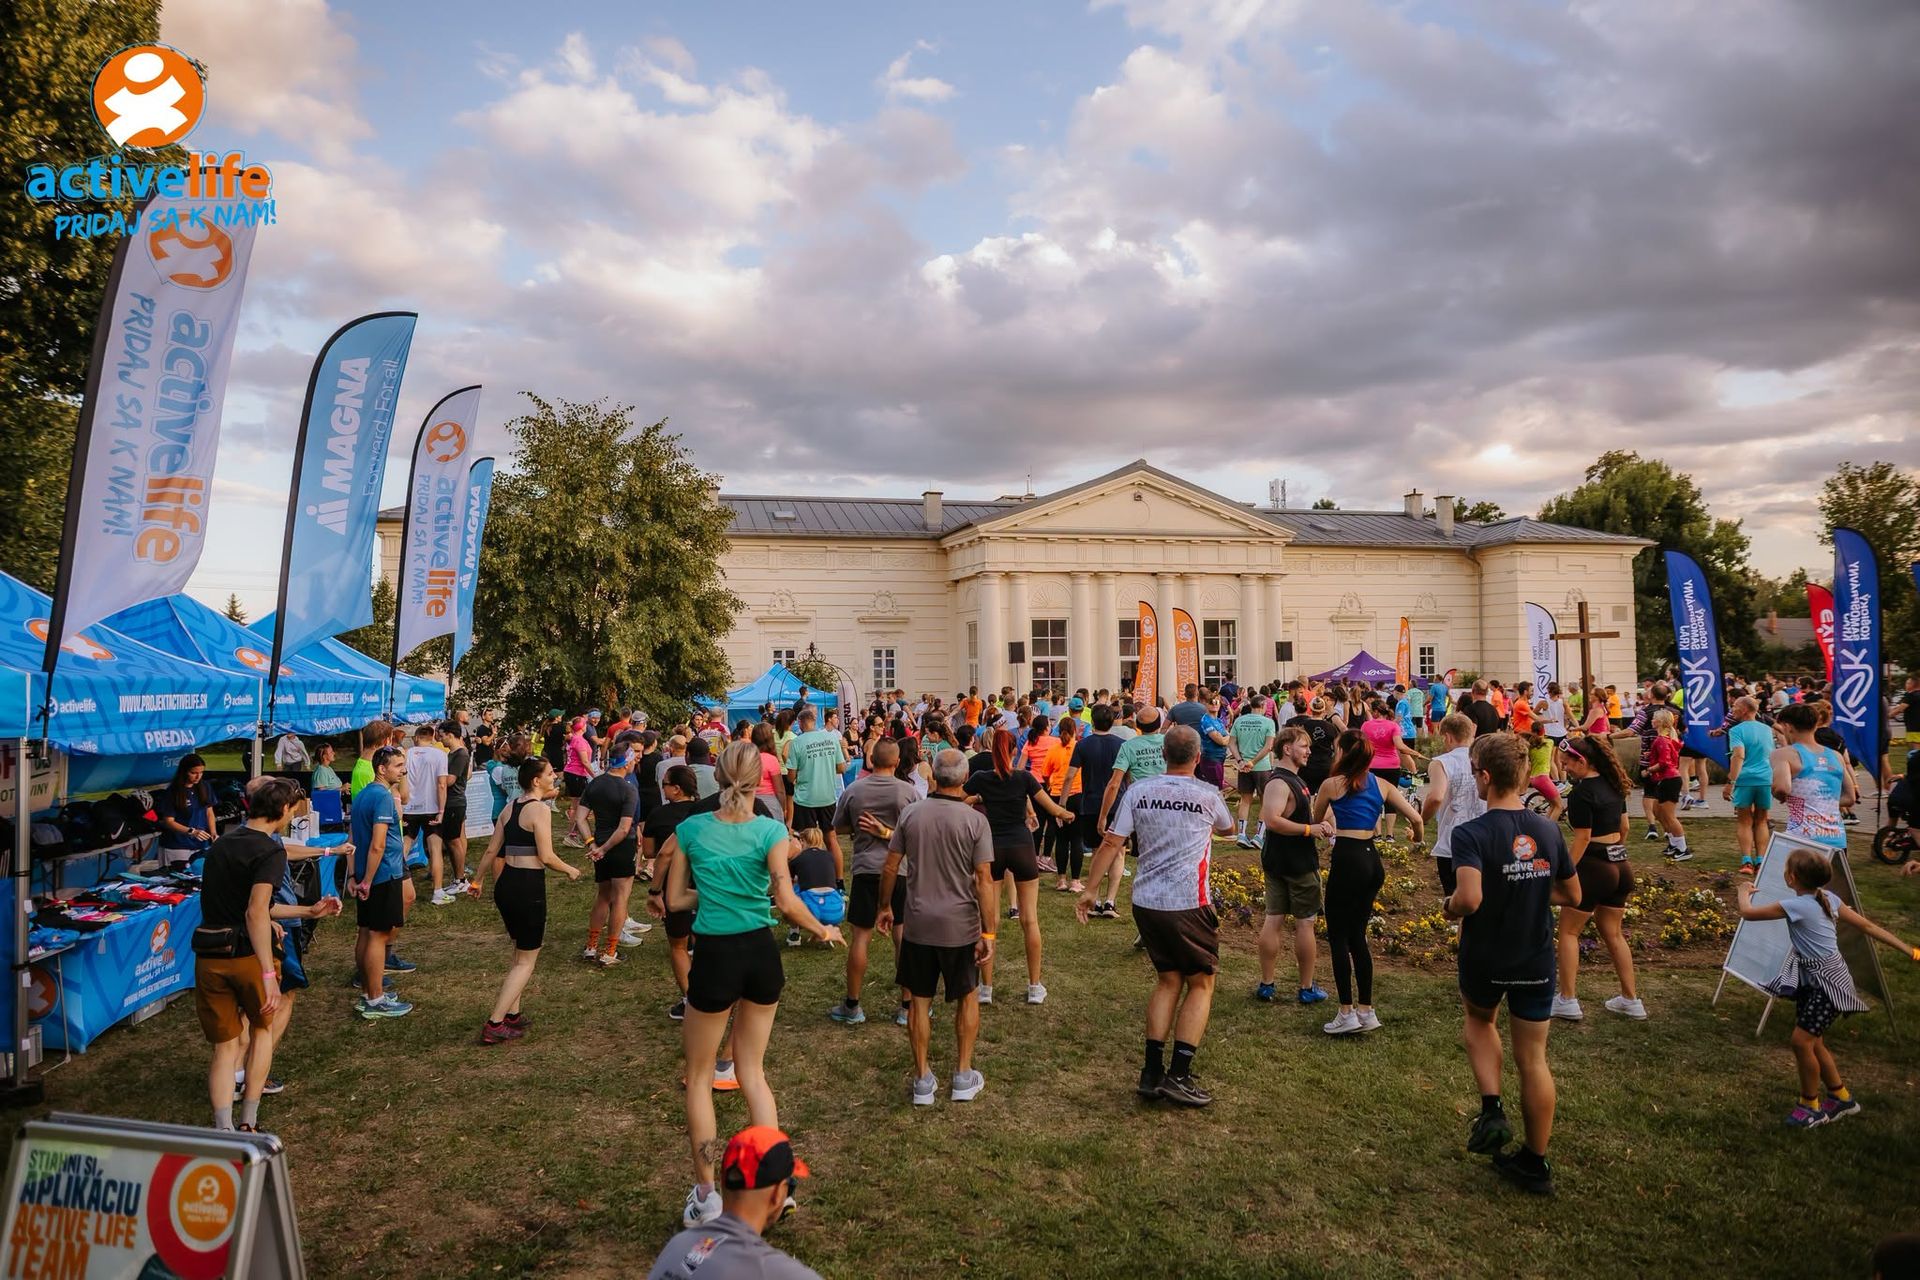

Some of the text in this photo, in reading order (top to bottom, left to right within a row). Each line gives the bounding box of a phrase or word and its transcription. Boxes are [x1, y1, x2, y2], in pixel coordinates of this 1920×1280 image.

[102, 291, 157, 536] PRIDAJ SA K NAM!
[321, 357, 371, 494] MAGNA
[136, 312, 211, 563] activelife
[415, 474, 431, 524] PRIDAJ
[413, 529, 427, 548] SA
[426, 477, 458, 618] activelife
[464, 485, 482, 569] MAGNA
[414, 553, 426, 564] K
[59, 698, 97, 714] activelife
[119, 693, 208, 714] WWW.PROJEKTACTIVELIFE.SK
[145, 729, 196, 750] PREDAJ
[1151, 799, 1203, 814] MAGNA
[28, 1149, 82, 1174] STIAHNI
[19, 1169, 142, 1217] APLIKÁCIU
[11, 1204, 138, 1249] ACTIVE LIFE
[7, 1236, 91, 1280] TEAM
